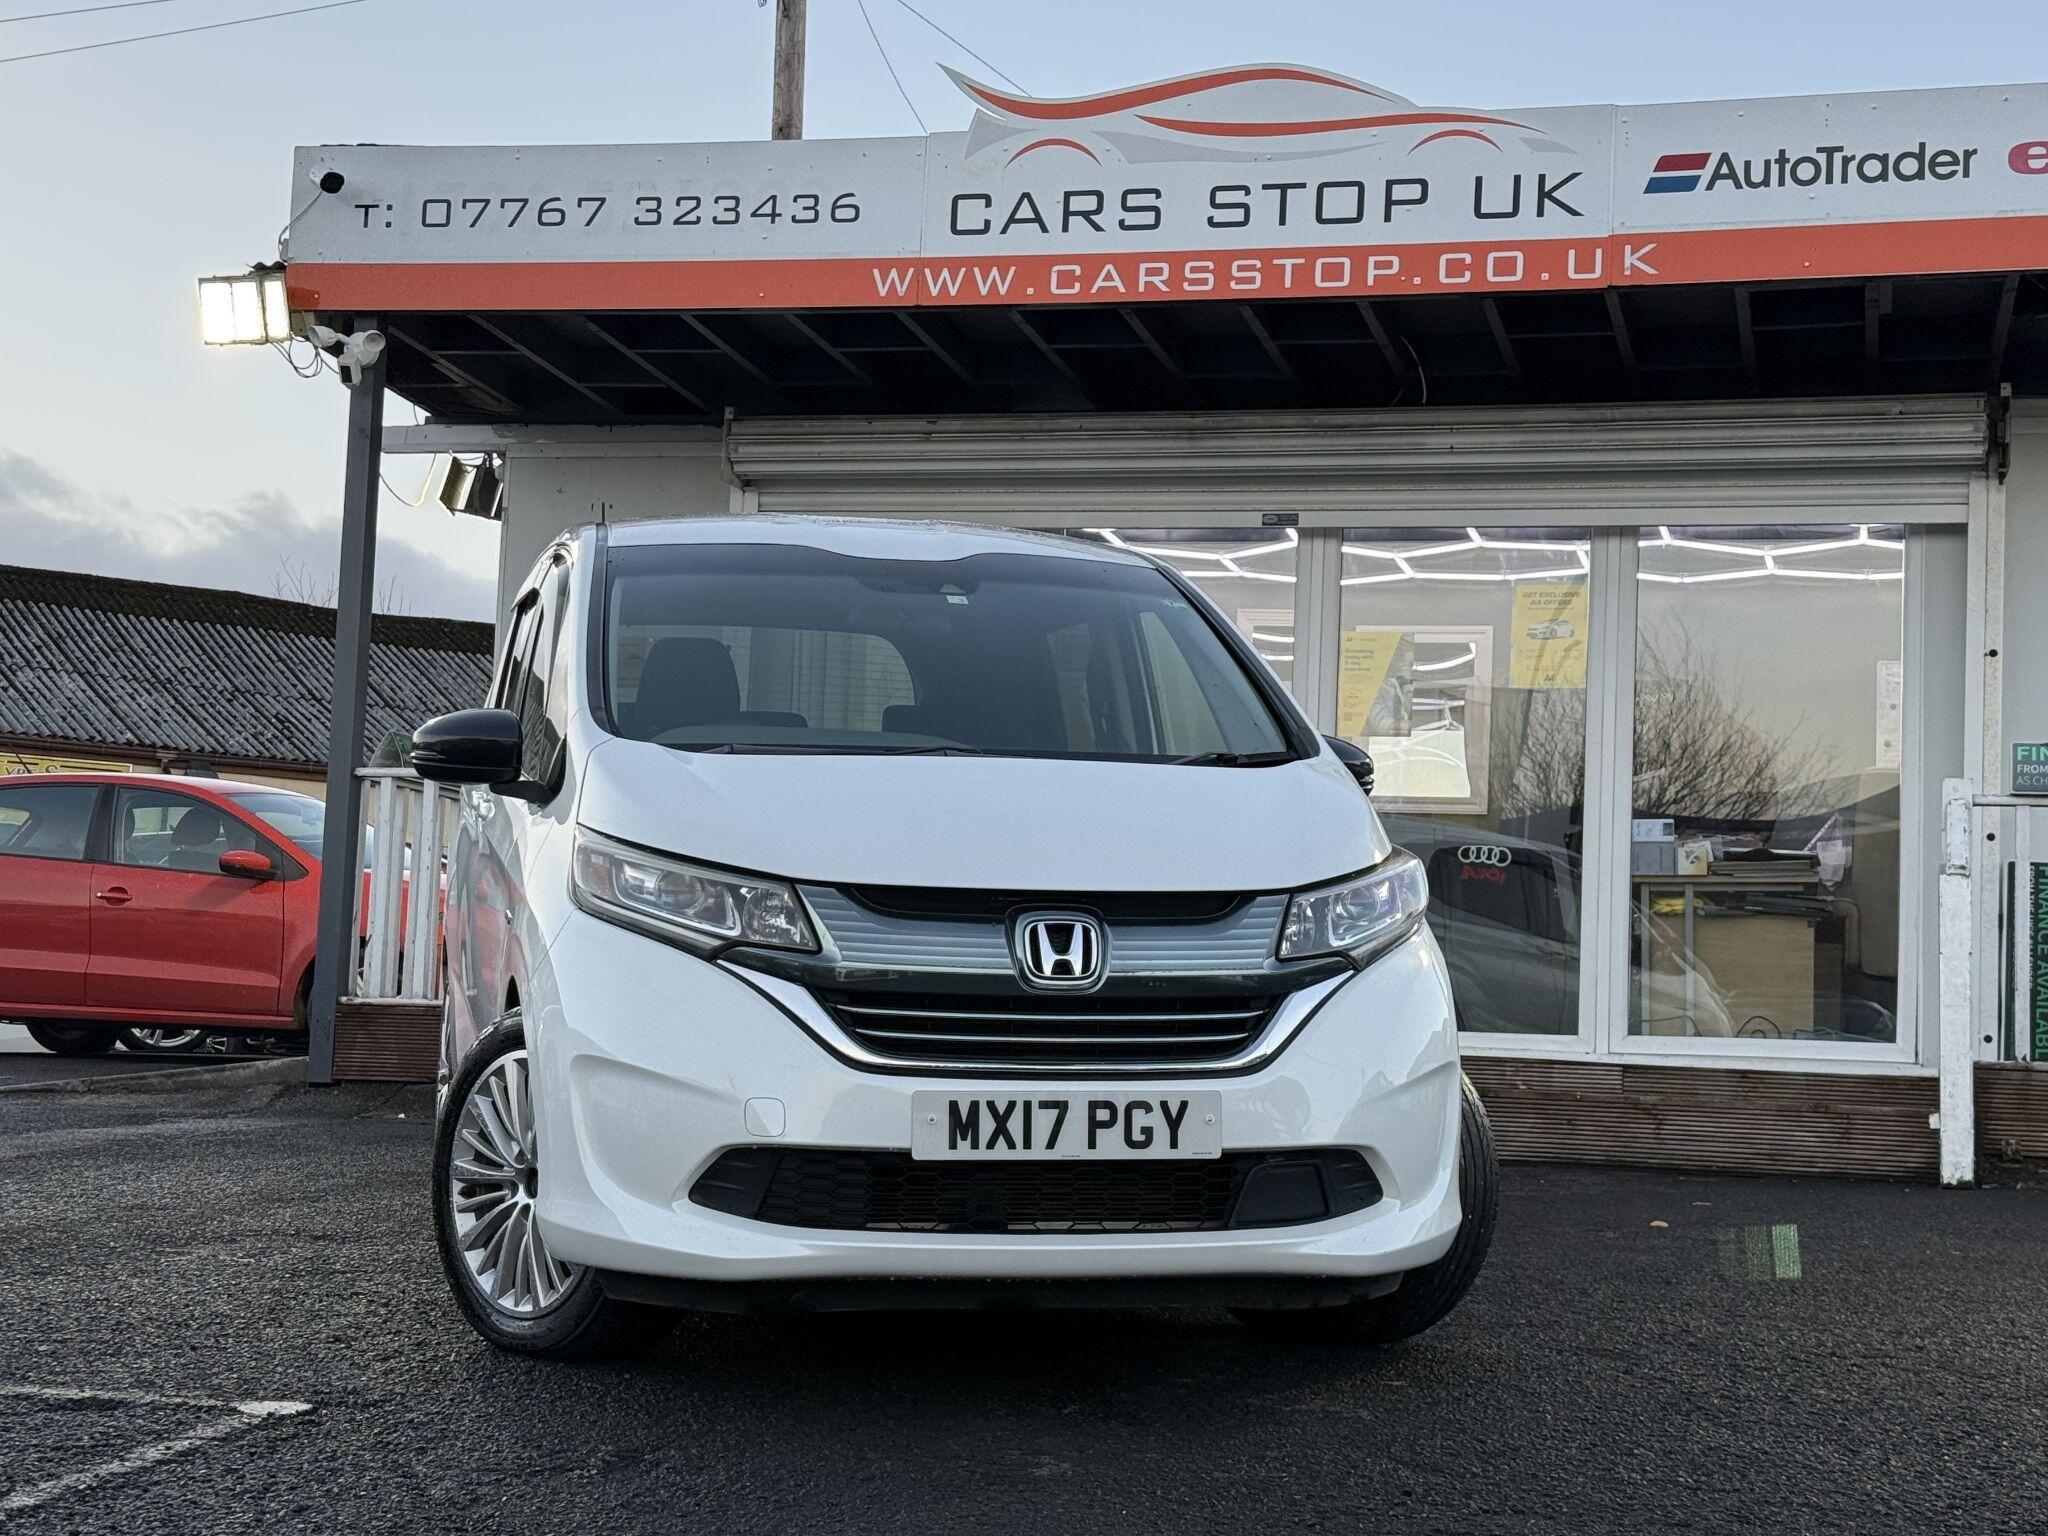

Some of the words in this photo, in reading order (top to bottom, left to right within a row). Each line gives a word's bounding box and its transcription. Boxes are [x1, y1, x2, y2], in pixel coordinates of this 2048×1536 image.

[1705, 141, 1978, 192] AutoTrader
[354, 203, 393, 229] T:
[421, 196, 607, 228] 07767
[633, 192, 861, 227] 323436
[950, 187, 1163, 236] CARS
[1207, 177, 1430, 230] STOP
[1473, 171, 1584, 220] UK
[872, 242, 1659, 298] WWW.CARSSTOP.CO.UK
[2016, 775, 2031, 786] AS
[2017, 764, 2048, 774] FROM
[948, 1100, 1069, 1151] MX17
[1087, 1100, 1189, 1151] PGY
